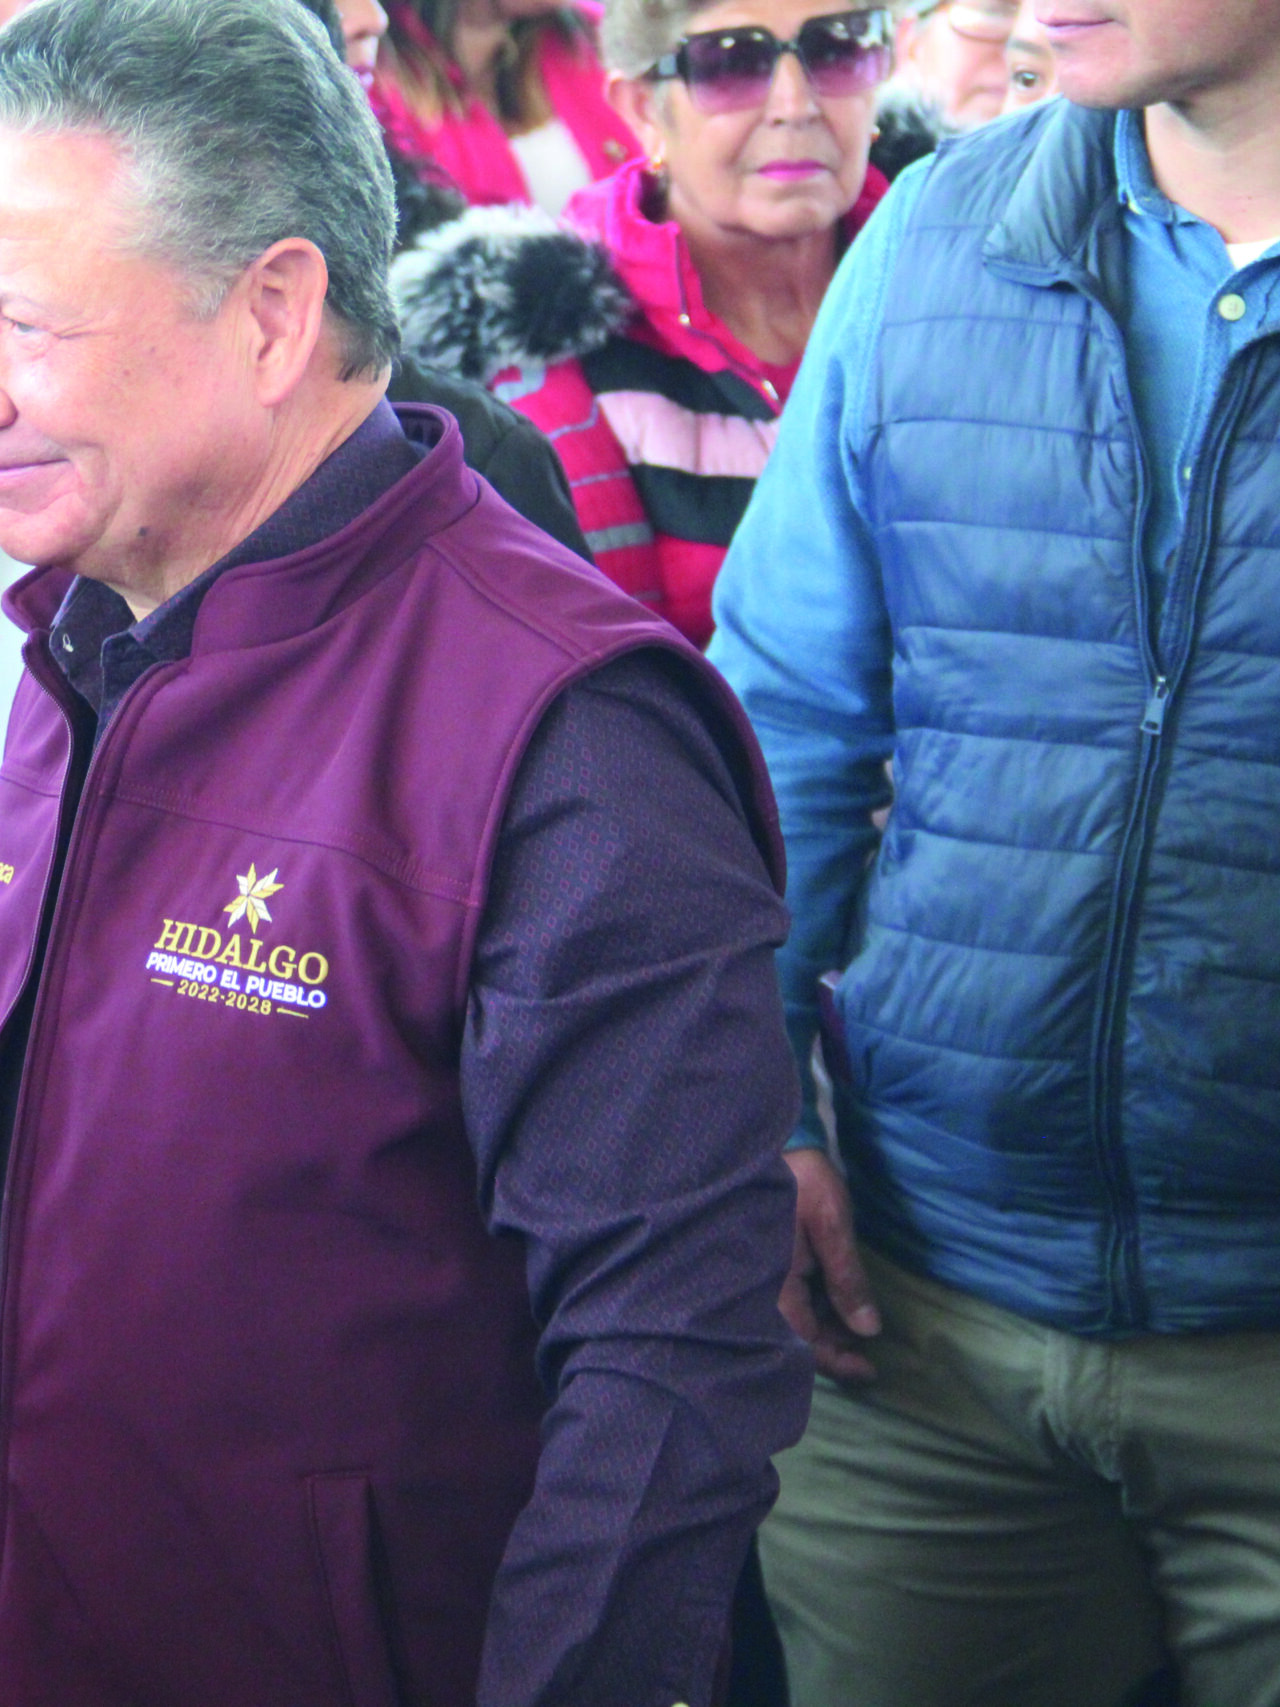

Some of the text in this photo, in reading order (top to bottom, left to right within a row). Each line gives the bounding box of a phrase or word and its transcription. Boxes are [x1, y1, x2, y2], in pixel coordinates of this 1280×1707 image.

[145, 951, 328, 1008] PRIMERO EL PUEBLO
[153, 918, 329, 985] HIDALGO
